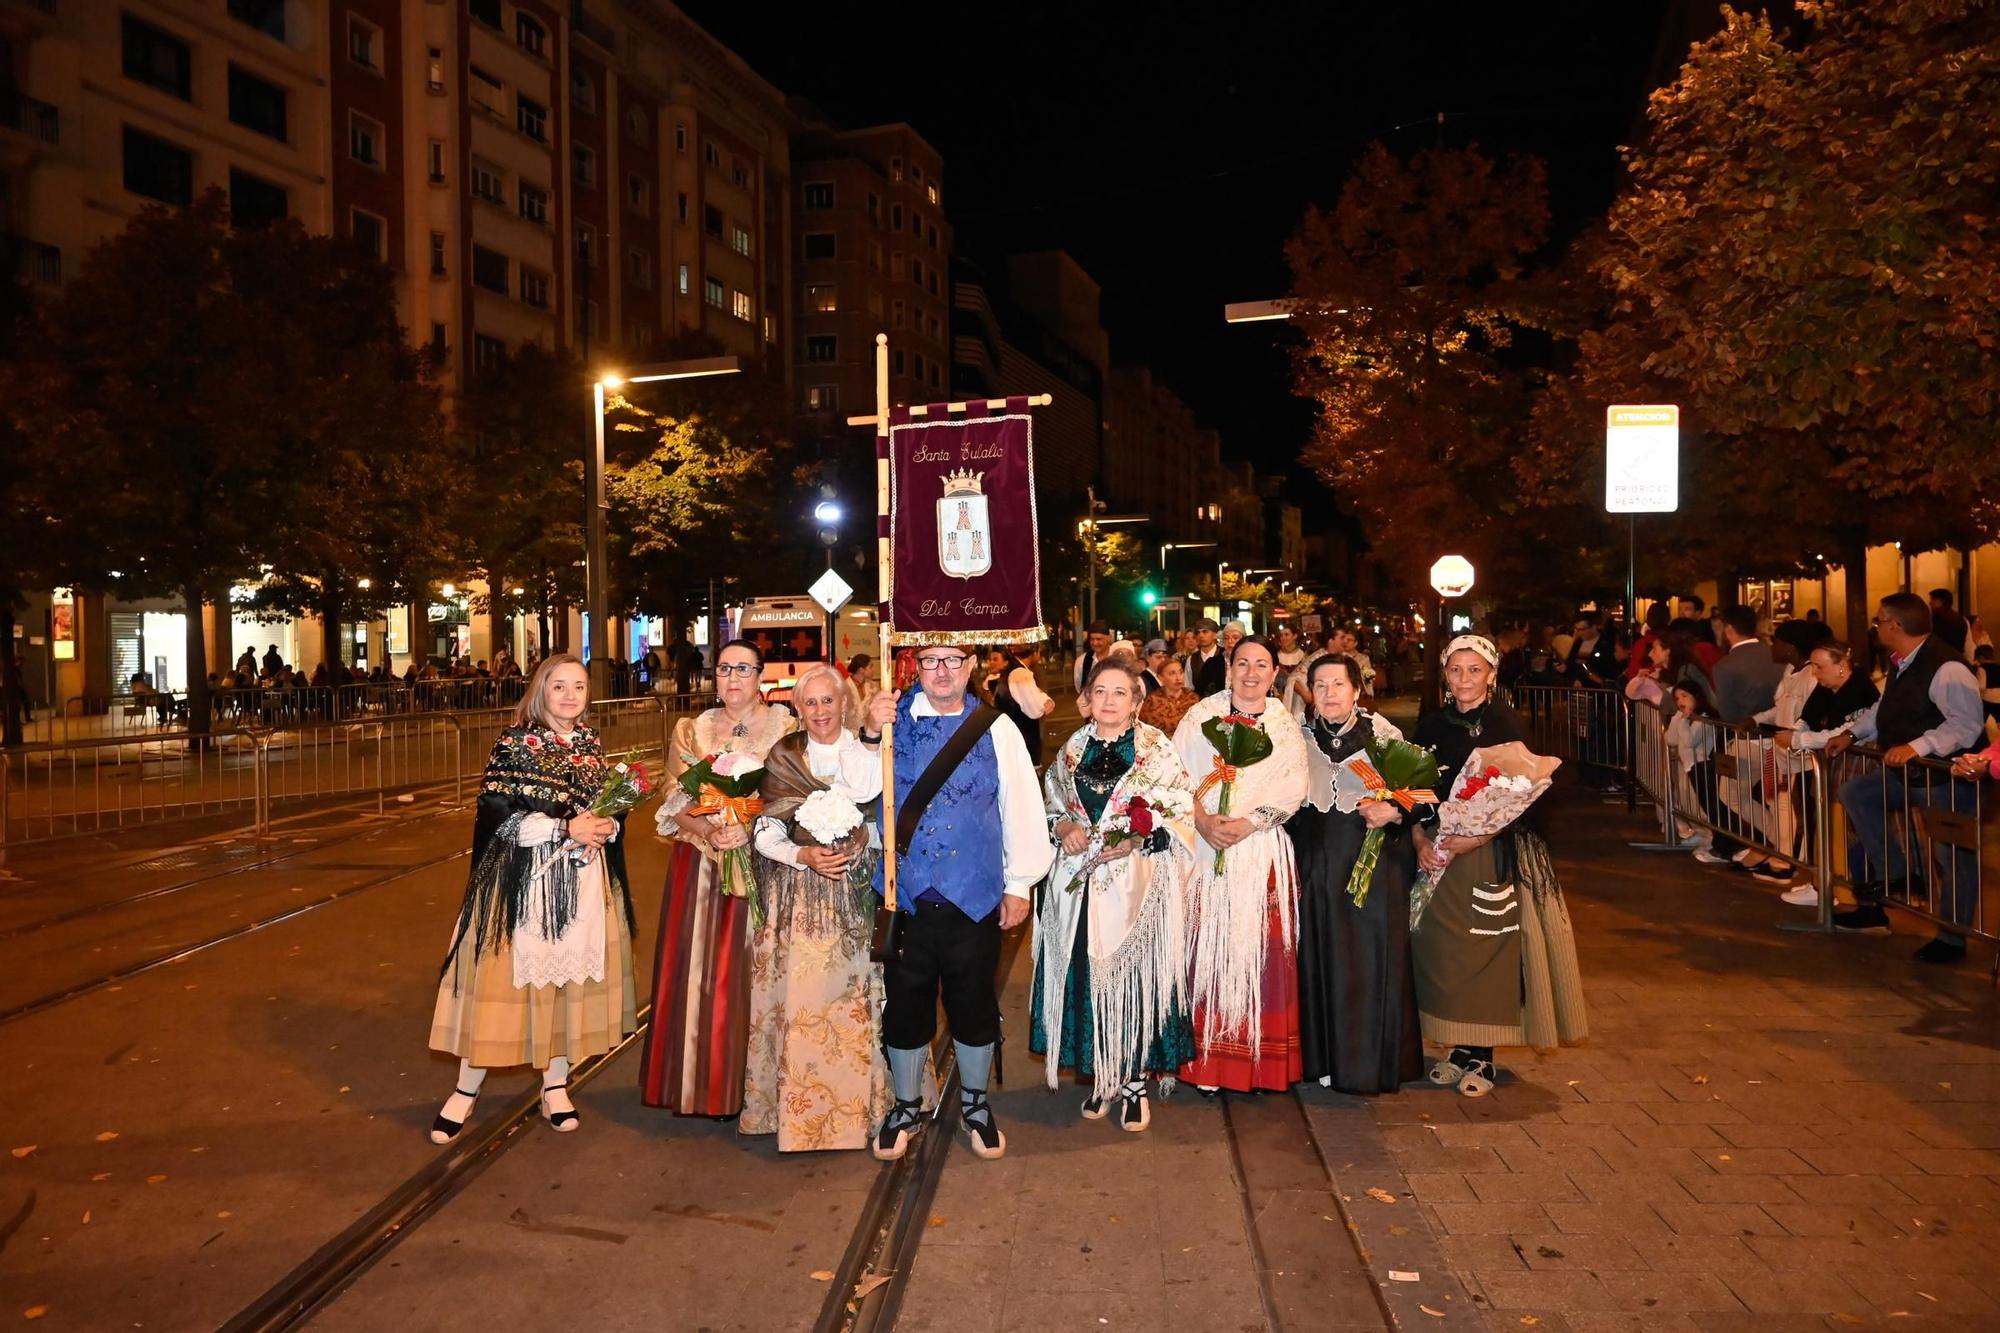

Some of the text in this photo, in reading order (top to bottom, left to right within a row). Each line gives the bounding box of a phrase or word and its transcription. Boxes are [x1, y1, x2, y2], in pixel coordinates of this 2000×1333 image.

[914, 442, 1003, 462] Santa Eulalia
[750, 611, 814, 622] AMBULANCIA
[920, 598, 1009, 619] Del Campo
